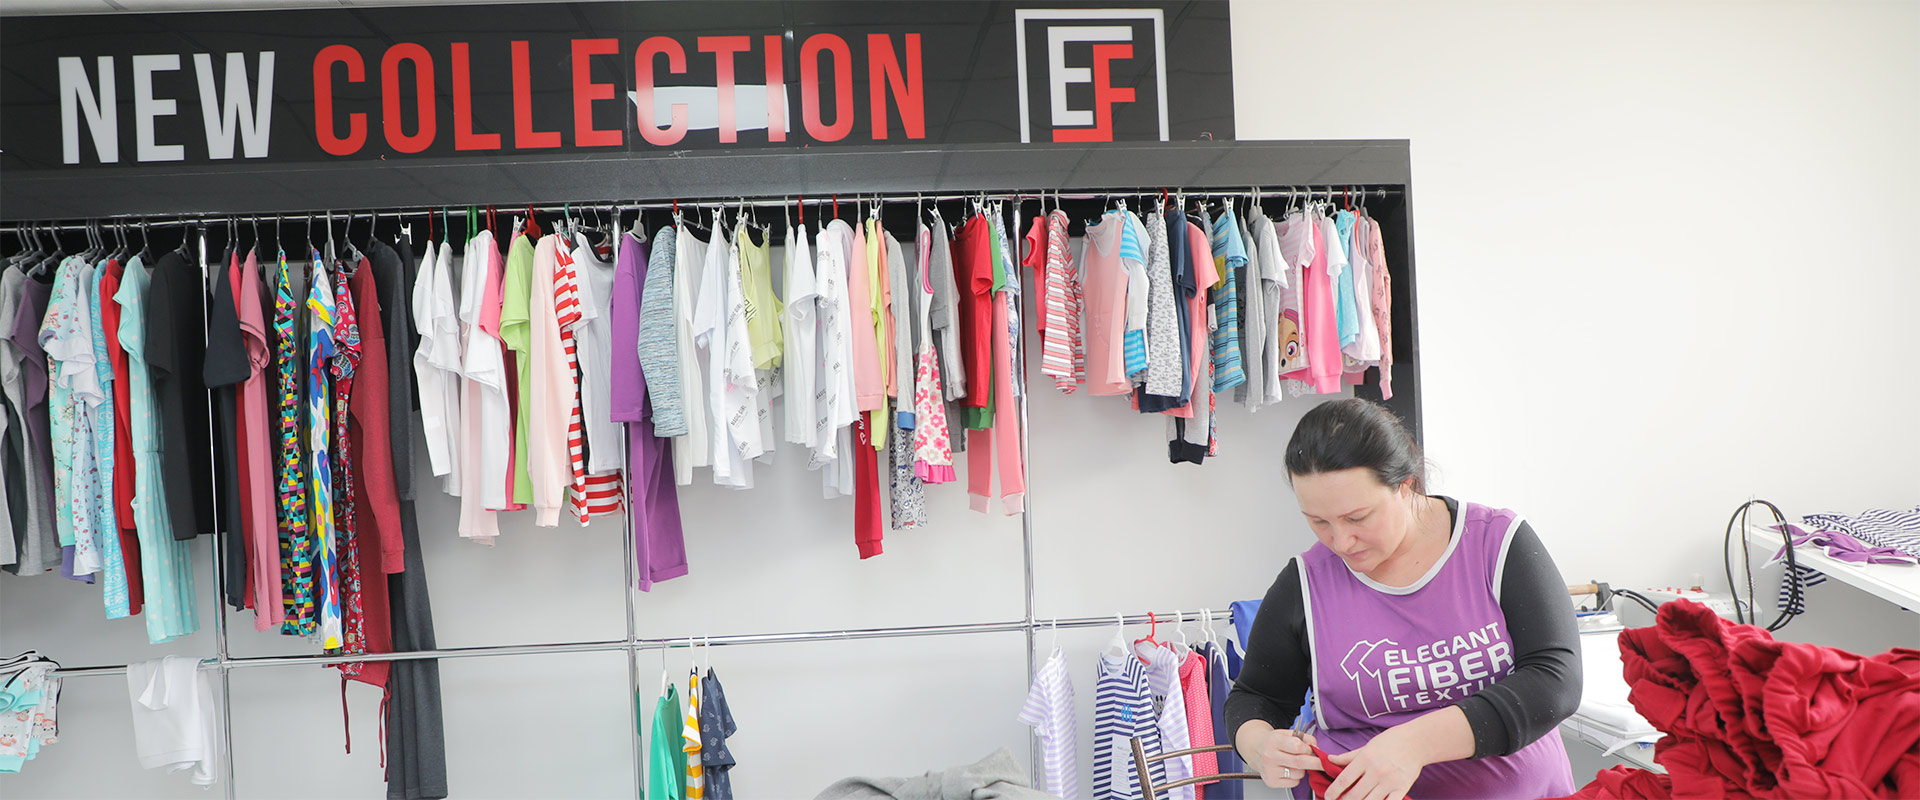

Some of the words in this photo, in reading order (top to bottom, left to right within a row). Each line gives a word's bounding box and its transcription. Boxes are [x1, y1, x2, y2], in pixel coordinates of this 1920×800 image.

[58, 51, 275, 164] NEW
[313, 33, 926, 154] COLLECTION
[1048, 26, 1136, 142] EF
[1384, 621, 1499, 666] ELEGANT
[1387, 641, 1514, 695] FIBER
[1394, 666, 1515, 709] TEXTI
